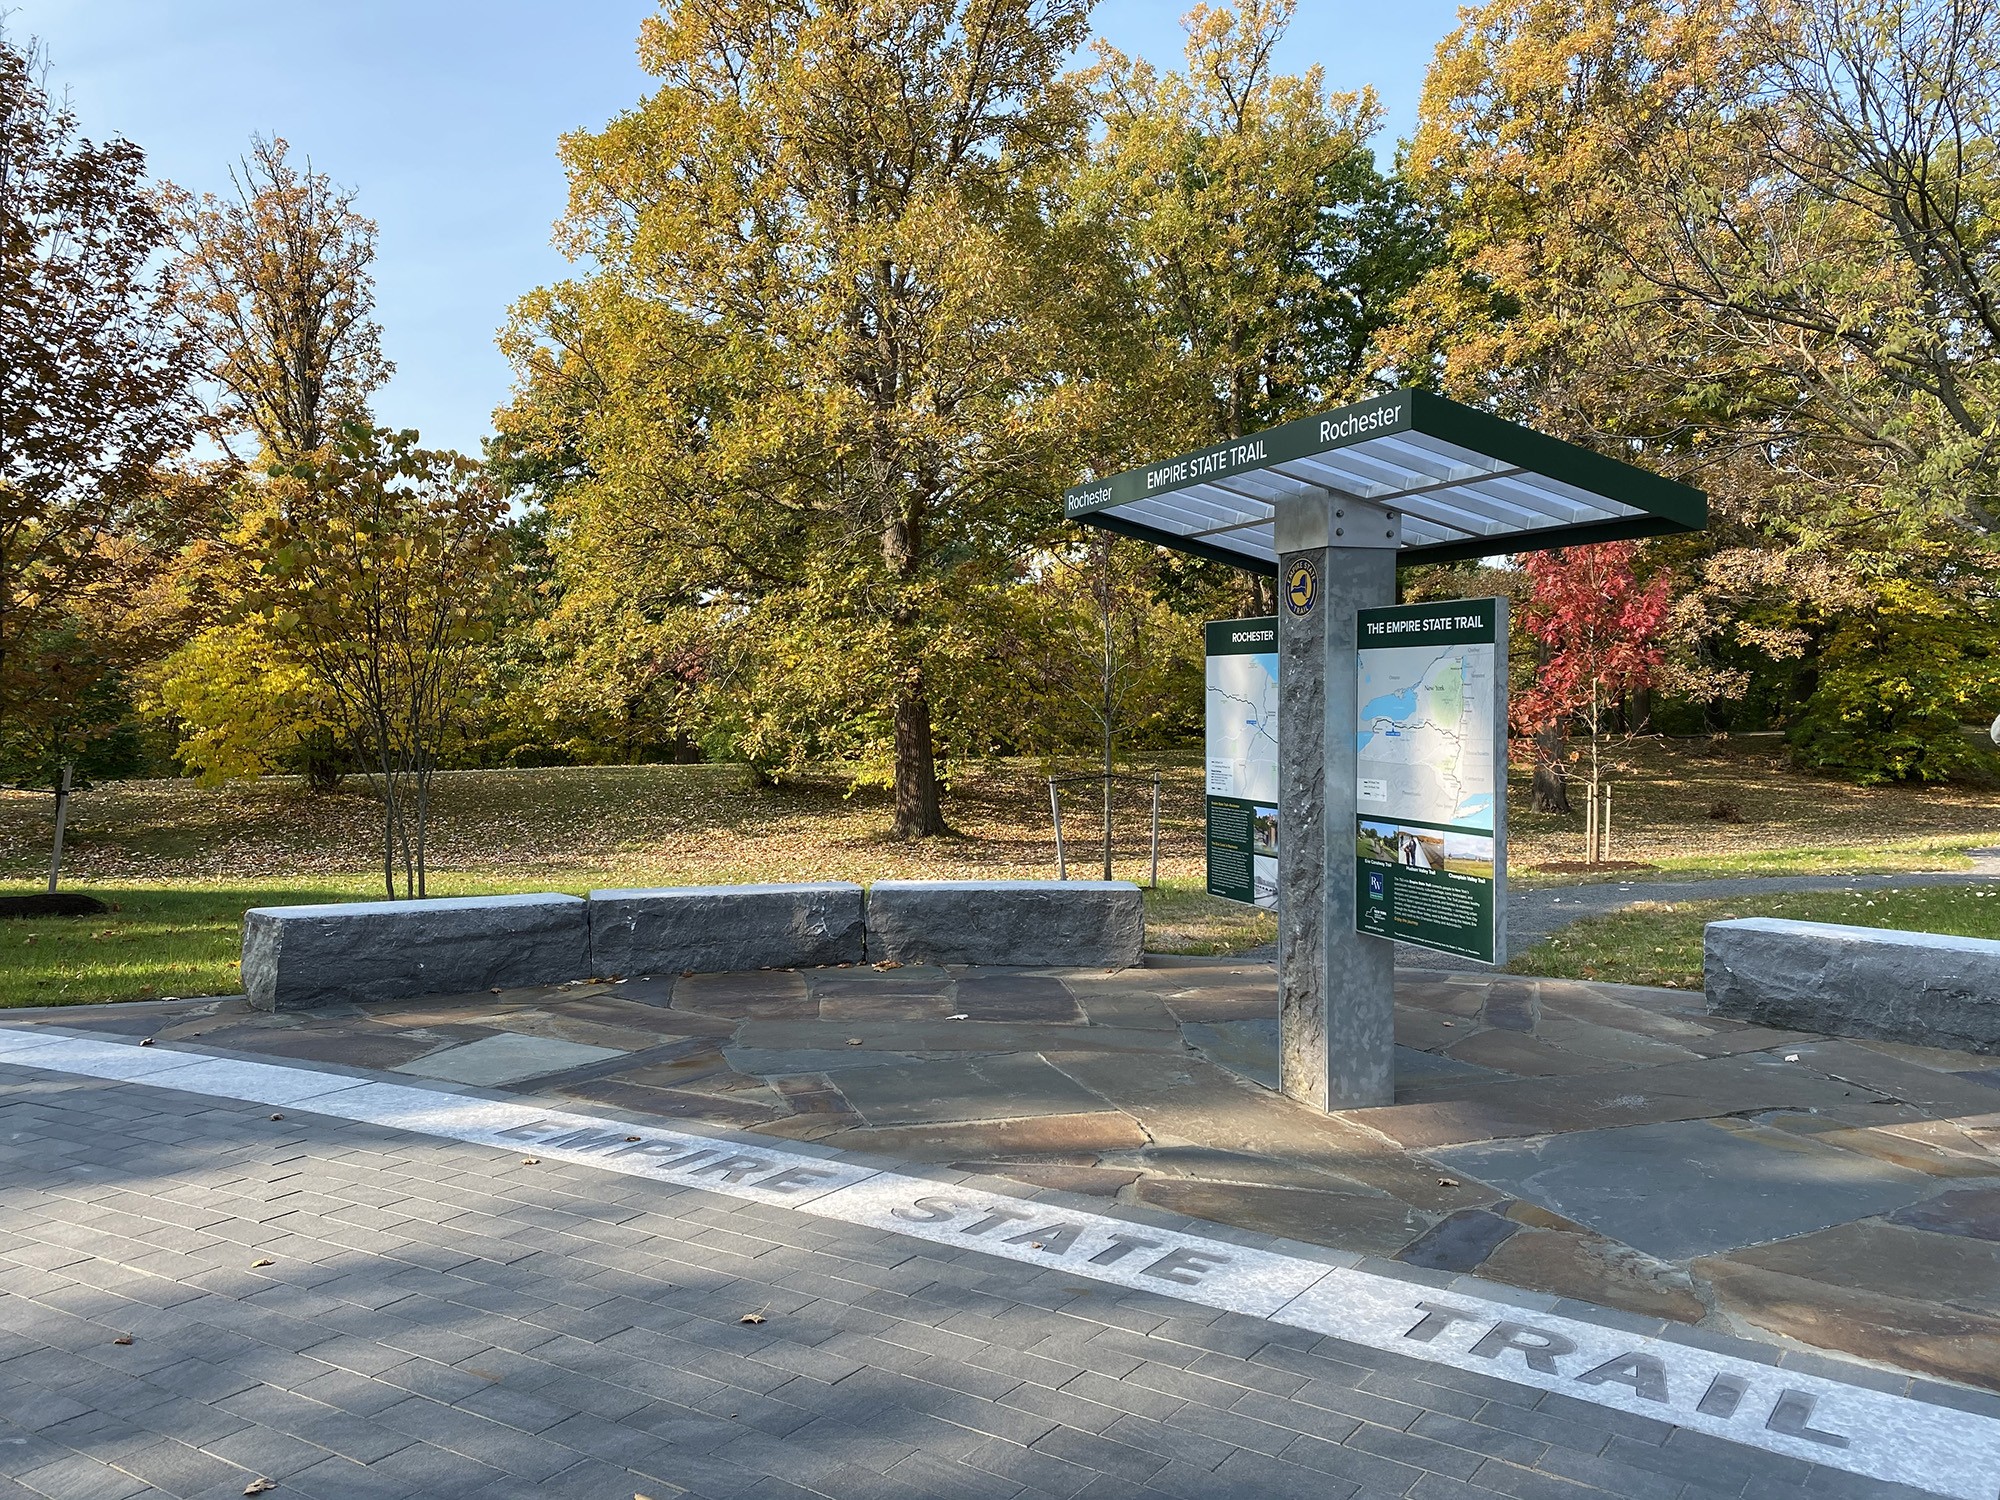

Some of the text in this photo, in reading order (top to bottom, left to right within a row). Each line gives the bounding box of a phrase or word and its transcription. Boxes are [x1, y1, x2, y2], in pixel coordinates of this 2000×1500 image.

[1320, 404, 1402, 443] Rochester
[1147, 440, 1267, 490] EMPIRE STATE TRAIL
[1068, 486, 1113, 511] Rochester
[1288, 561, 1316, 584] EMPIRE STATE
[1293, 606, 1309, 614] TRAIL
[1232, 630, 1274, 643] ROCHESTER
[1367, 615, 1484, 635] THE EMPIRE STATE TRAIL
[494, 1119, 1850, 1449] EMPIRE STATE TRAIL
